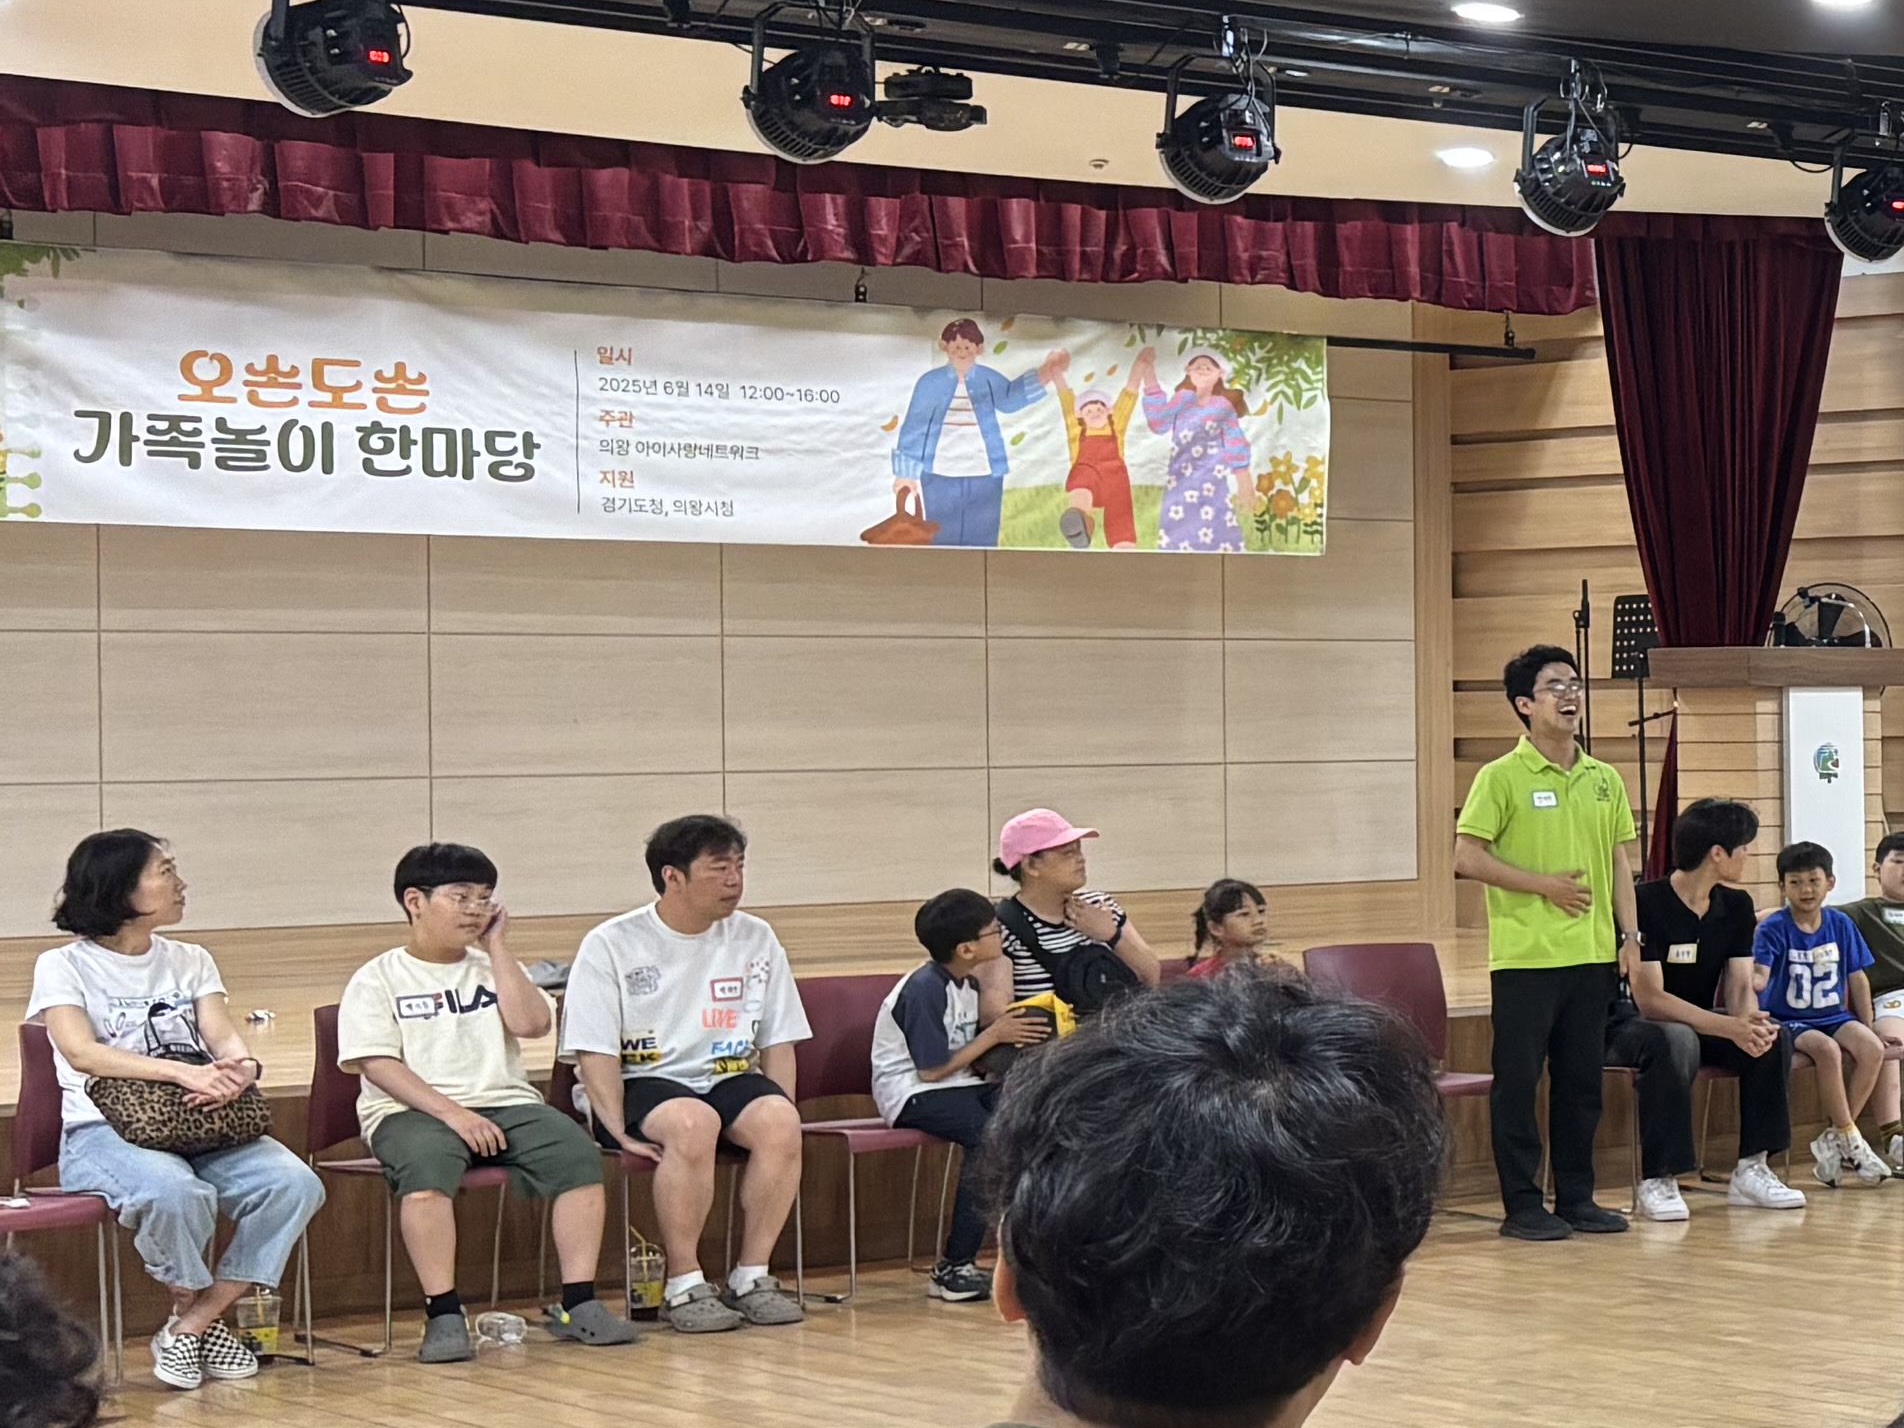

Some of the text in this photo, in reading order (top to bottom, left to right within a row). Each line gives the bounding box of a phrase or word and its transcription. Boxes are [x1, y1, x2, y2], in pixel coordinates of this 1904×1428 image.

[597, 346, 632, 365] 일시
[177, 349, 430, 415] 오손도손
[599, 377, 840, 404] 2025년 6월 14일 12:00~16:00
[598, 410, 635, 428] 주관
[73, 409, 541, 483] 가족놀이 한마당
[599, 439, 760, 460] 의왕 아이사랑네트워크
[599, 470, 635, 489] 지원
[602, 496, 735, 517] 경기도청, 의왕시청
[1786, 962, 1841, 1009] 02
